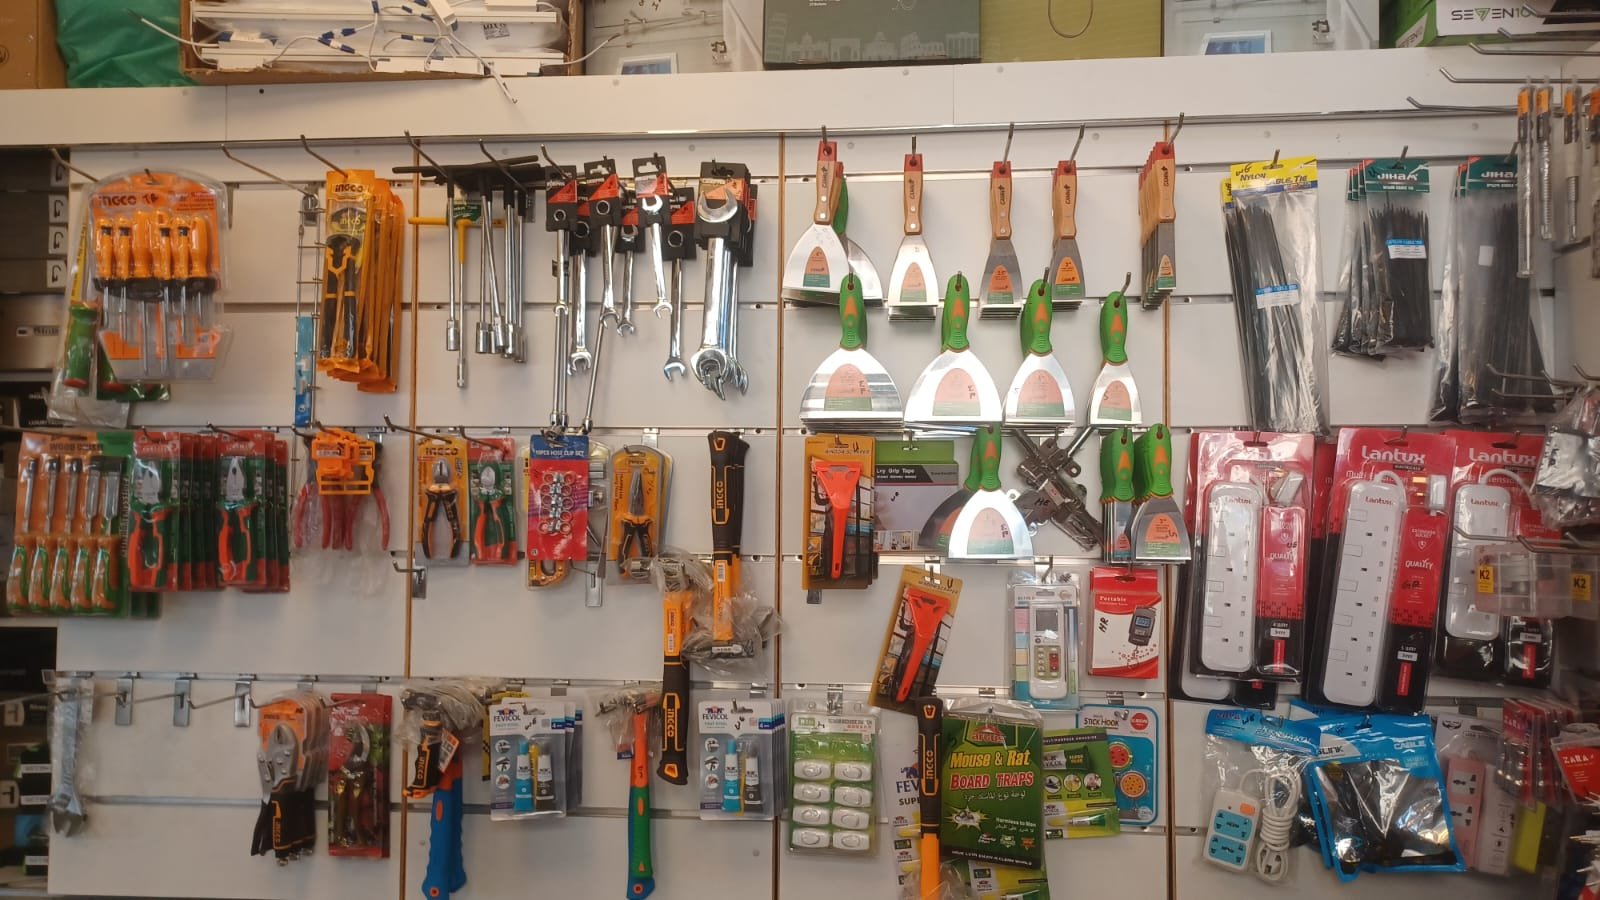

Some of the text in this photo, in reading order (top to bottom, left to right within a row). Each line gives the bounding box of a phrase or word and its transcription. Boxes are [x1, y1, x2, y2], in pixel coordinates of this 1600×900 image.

[1240, 173, 1267, 181] NYLON
[1362, 446, 1426, 466] Lantux
[1405, 559, 1434, 570] QUALITY
[1479, 569, 1490, 580] K2
[1573, 578, 1586, 589] K2
[493, 714, 521, 723] FEVICOL
[702, 713, 729, 721] FEVICOL
[950, 749, 1031, 769] Mouse & Rat
[950, 771, 1034, 791] BOARD TRAPS
